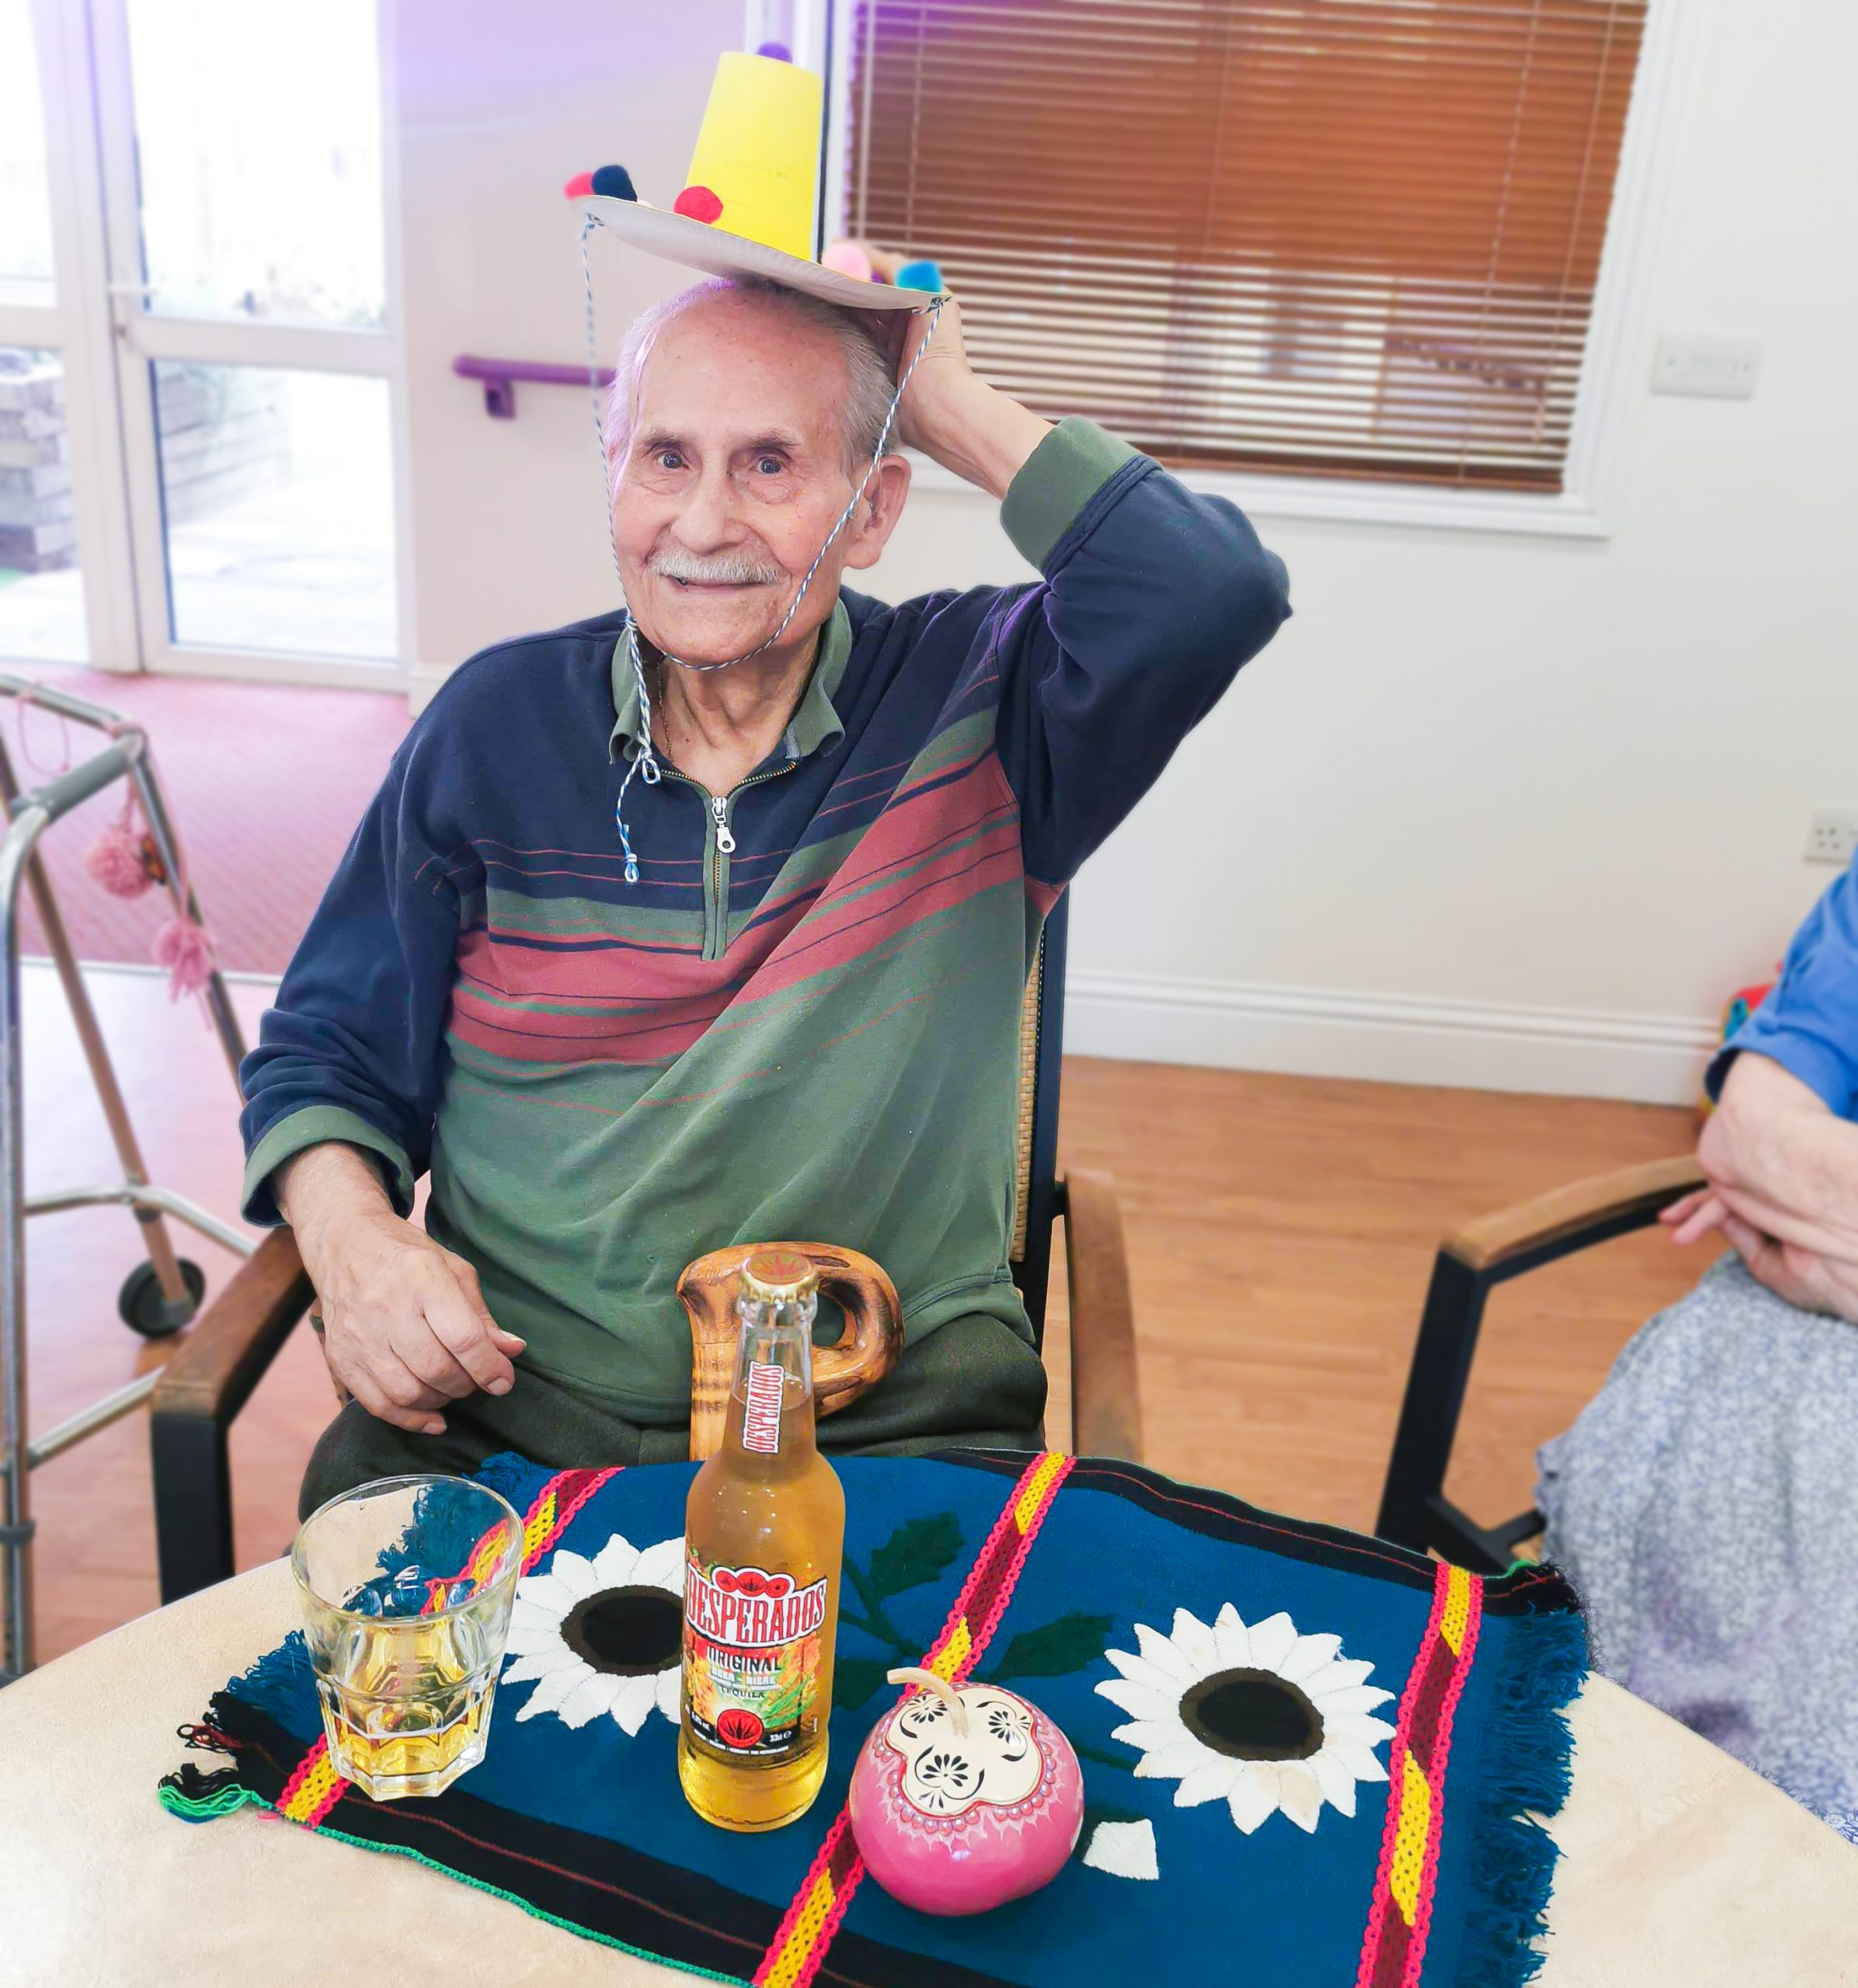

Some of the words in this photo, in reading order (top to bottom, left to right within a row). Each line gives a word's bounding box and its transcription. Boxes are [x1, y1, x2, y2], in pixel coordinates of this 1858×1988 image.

[746, 1364, 781, 1451] DESPERADOS
[688, 1571, 825, 1643] DESPERADOS
[708, 1646, 782, 1672] ORIGINAL
[719, 1684, 765, 1698] TEQUILA
